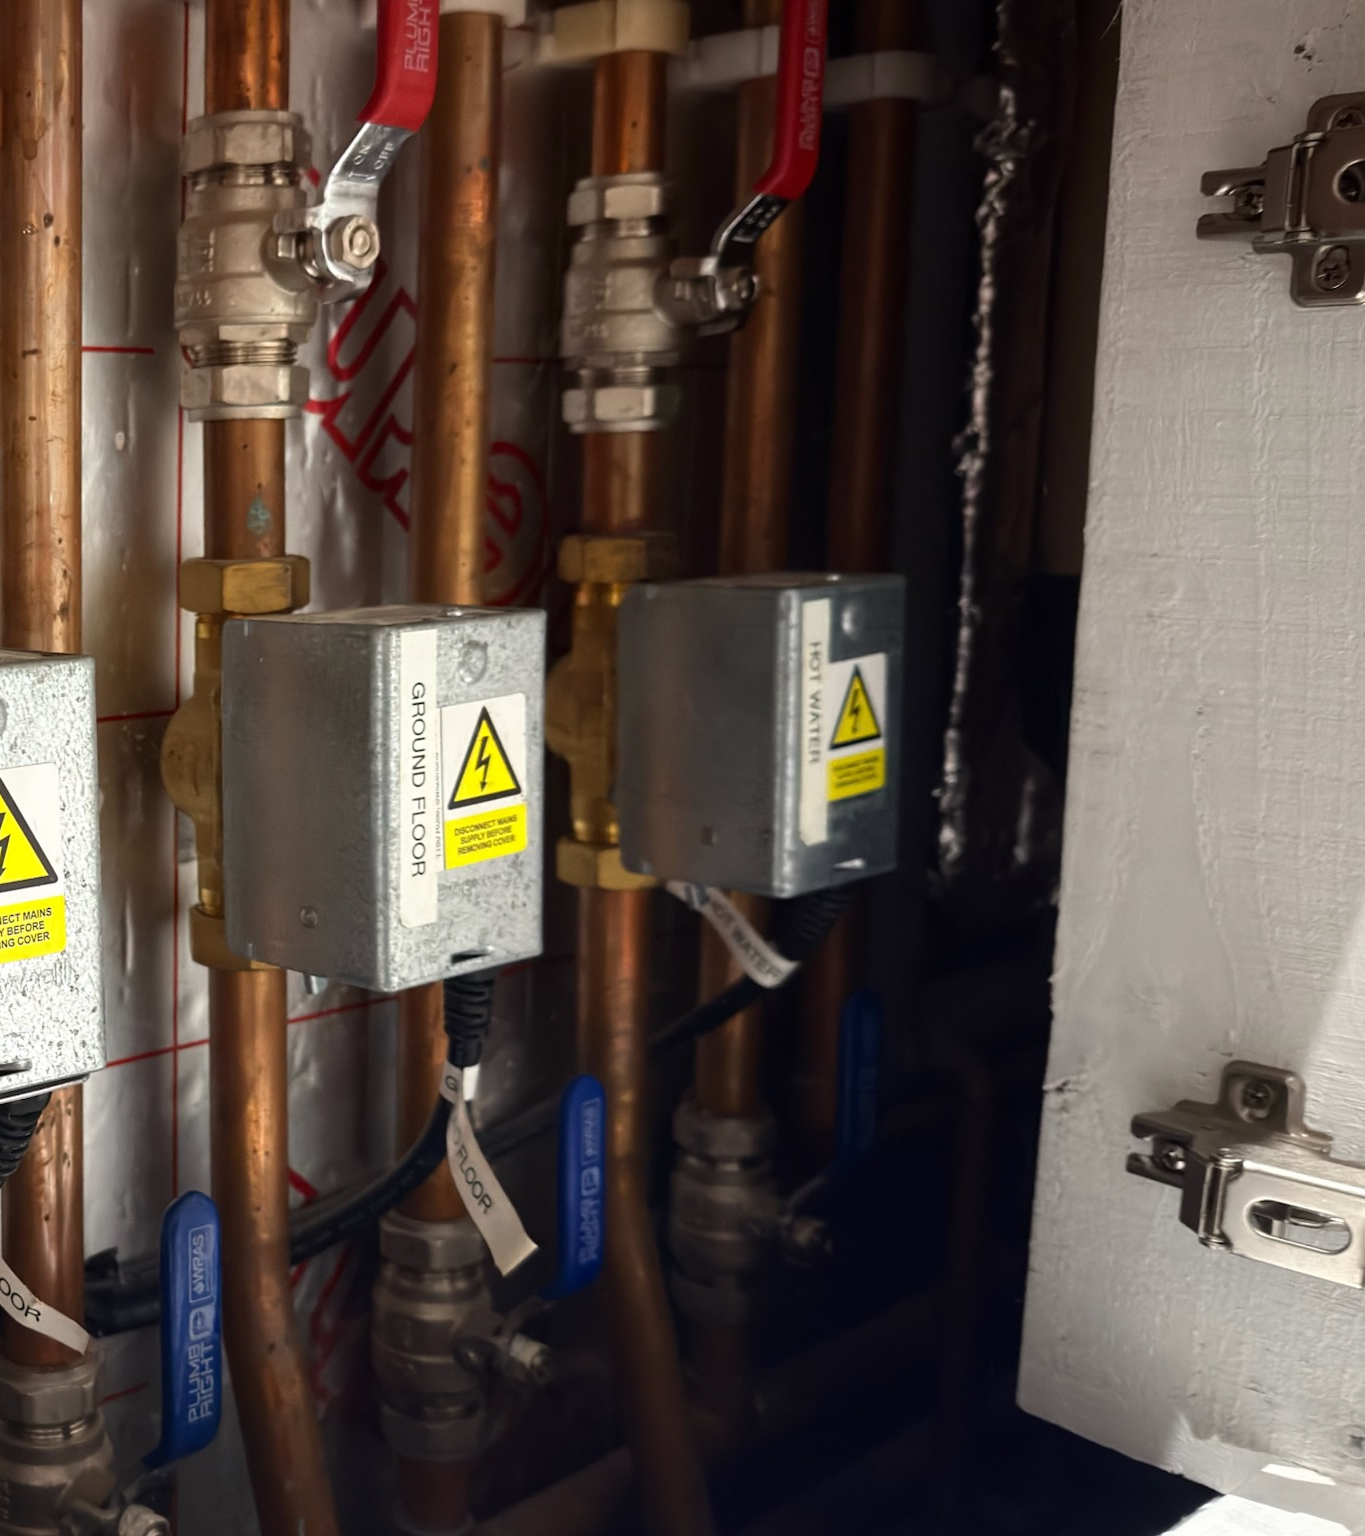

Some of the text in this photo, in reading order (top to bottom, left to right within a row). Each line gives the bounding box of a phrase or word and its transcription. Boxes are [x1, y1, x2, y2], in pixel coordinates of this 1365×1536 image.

[353, 144, 372, 166] ON
[808, 641, 822, 764] HOT WATER
[411, 682, 426, 877] GROUND FLOOR
[454, 814, 517, 836] DISCONNECT MAINS
[460, 825, 512, 844] SUPPLY BEFORE
[458, 834, 515, 855] REMOVING COVER
[23, 907, 52, 921] MAINS
[7, 921, 45, 935] BEFORE
[17, 932, 50, 945] COVER
[456, 1144, 493, 1215] FLOOR
[192, 1234, 205, 1284] WRAS
[188, 1343, 202, 1422] PLUMB
[199, 1342, 215, 1418] RIGHT
